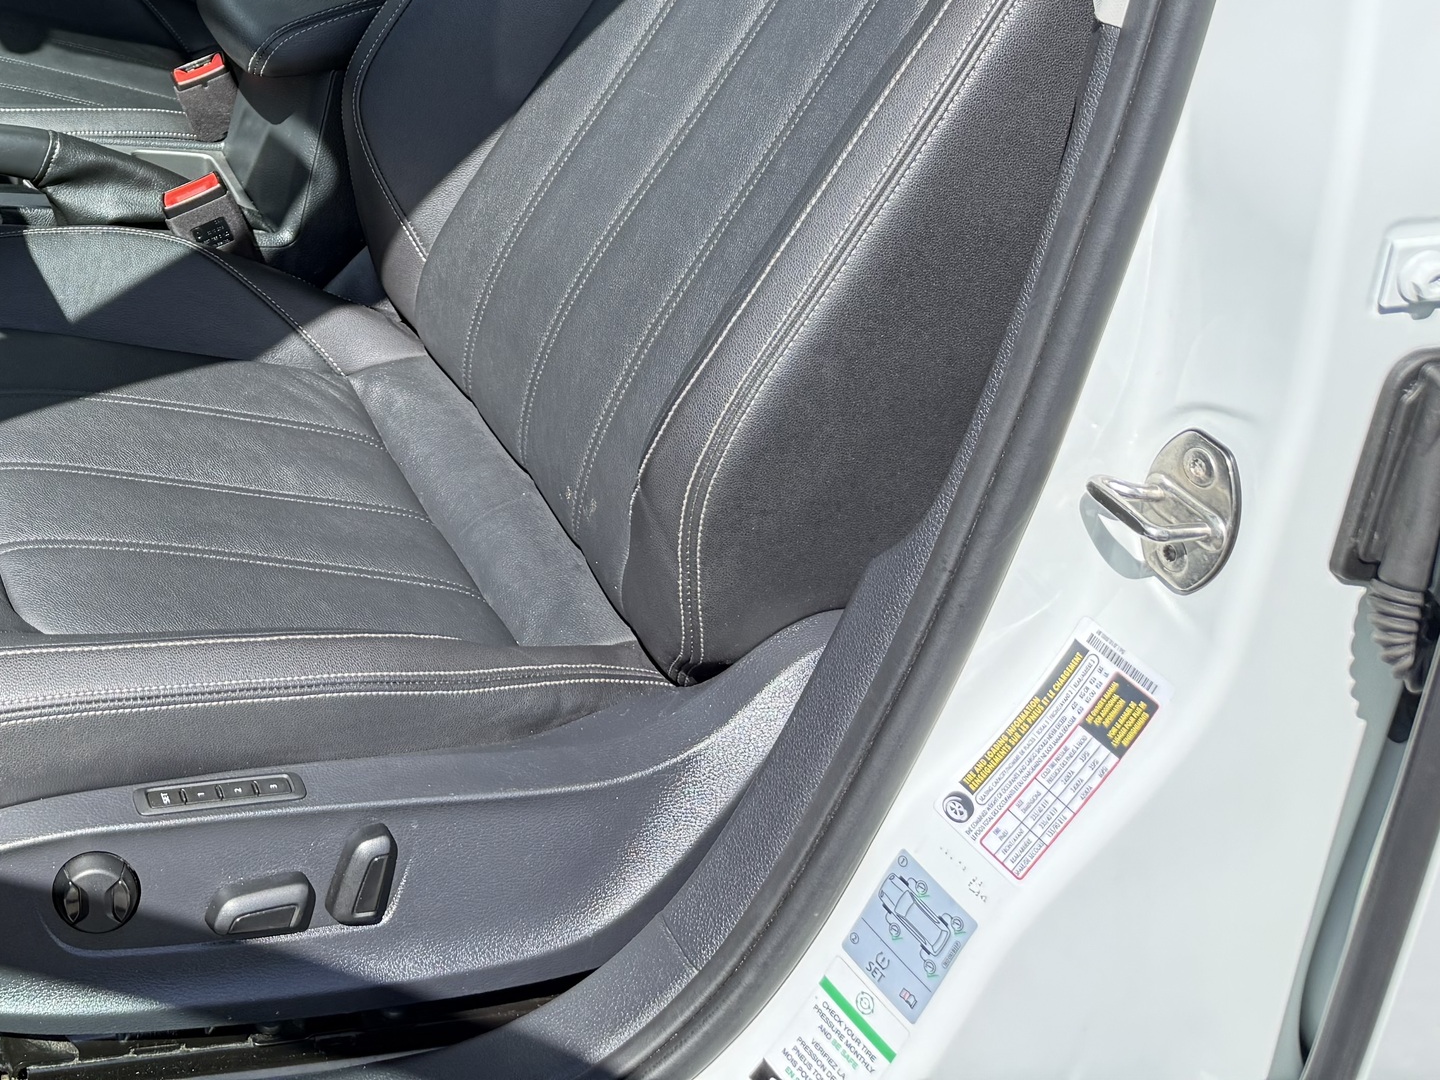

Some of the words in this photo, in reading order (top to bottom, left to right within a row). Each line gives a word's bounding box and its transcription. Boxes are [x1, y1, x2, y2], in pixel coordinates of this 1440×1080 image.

[1050, 651, 1084, 691] CHARGEMENT
[1040, 696, 1050, 706] ET
[1046, 689, 1055, 698] LE
[1025, 703, 1044, 724] PNEUS
[1008, 731, 1021, 746] SUR
[1018, 721, 1030, 734] LES
[962, 769, 977, 785] TIRE
[972, 757, 987, 773] AND
[983, 732, 1008, 761] LOADING
[1005, 694, 1041, 736] INFORMATION
[968, 741, 1012, 793] RENSEIGNEMENTS
[863, 960, 886, 983] SET
[810, 1003, 847, 1041] PRESSURE
[841, 1038, 877, 1074] MONTHLY
[819, 1000, 845, 1026] CHECK
[840, 1023, 863, 1046] YOUR
[859, 1043, 878, 1062] TIRE
[779, 1047, 800, 1068] MOIS
[789, 1045, 815, 1071] PNEUS
[793, 1036, 829, 1072] PRESSION
[816, 1023, 834, 1041] AND
[829, 1038, 843, 1051] BE
[838, 1048, 860, 1070] SAFE
[783, 1065, 796, 1078] EN
[835, 1066, 848, 1079] LA
